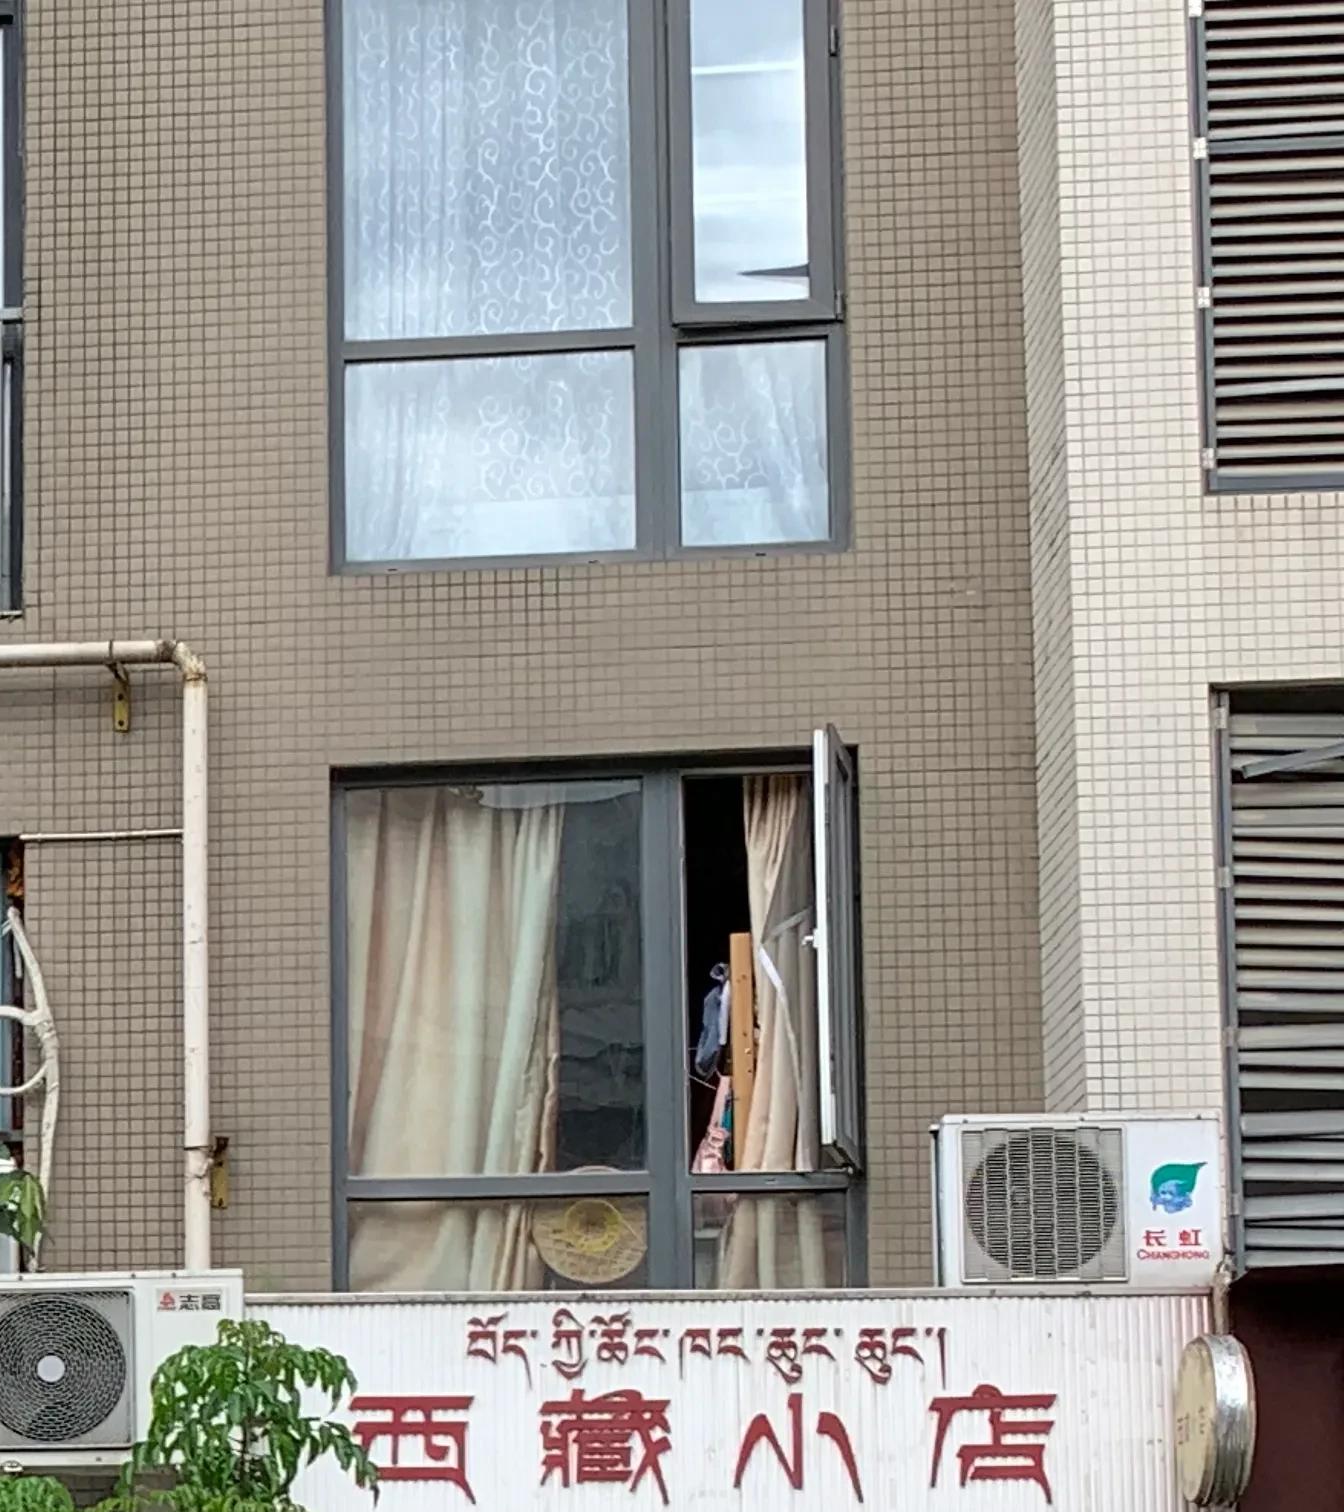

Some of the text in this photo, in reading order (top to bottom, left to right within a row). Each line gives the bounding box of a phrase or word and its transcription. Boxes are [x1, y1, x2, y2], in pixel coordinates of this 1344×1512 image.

[1143, 1229, 1202, 1247] 长虹
[347, 1385, 1059, 1507] 西藏小店
